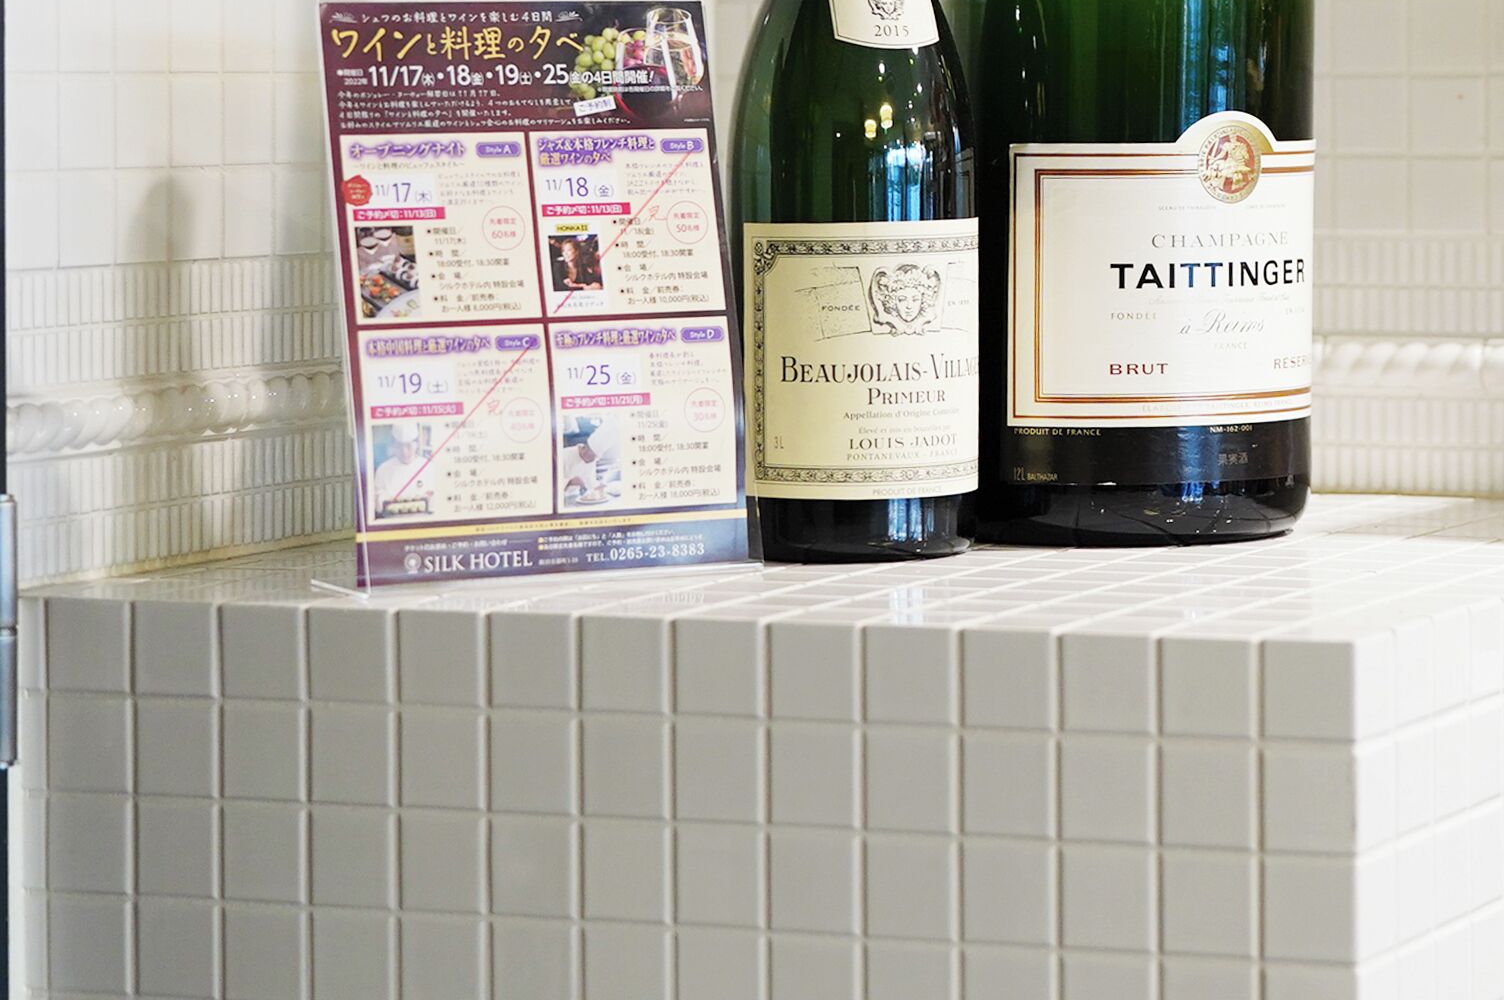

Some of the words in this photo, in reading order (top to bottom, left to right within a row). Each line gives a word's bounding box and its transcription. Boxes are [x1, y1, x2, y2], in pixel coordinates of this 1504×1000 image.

[874, 24, 910, 38] 2015
[331, 25, 584, 63] ワインと料理の夕べ
[350, 141, 465, 159] オープニングナイト
[504, 144, 513, 154] A
[687, 139, 695, 150] B
[538, 149, 613, 167] 厳選ワインの夕べ
[1151, 231, 1289, 249] CHAMPAGNE
[1109, 258, 1305, 290] TAITTINGER
[707, 329, 715, 339] D
[522, 337, 530, 347] C
[1109, 362, 1169, 376] BRUT
[867, 387, 946, 406] PRIMEUR
[843, 410, 894, 421] Appellation
[1014, 427, 1049, 437] PRODUIT
[1052, 428, 1063, 437] DE
[1066, 428, 1101, 437] FRANCE
[849, 436, 906, 451] LOUIS
[909, 433, 958, 447] JADOT
[872, 487, 905, 497] PRODUIT
[424, 553, 466, 574] SILK
[470, 550, 534, 571] HOTEL
